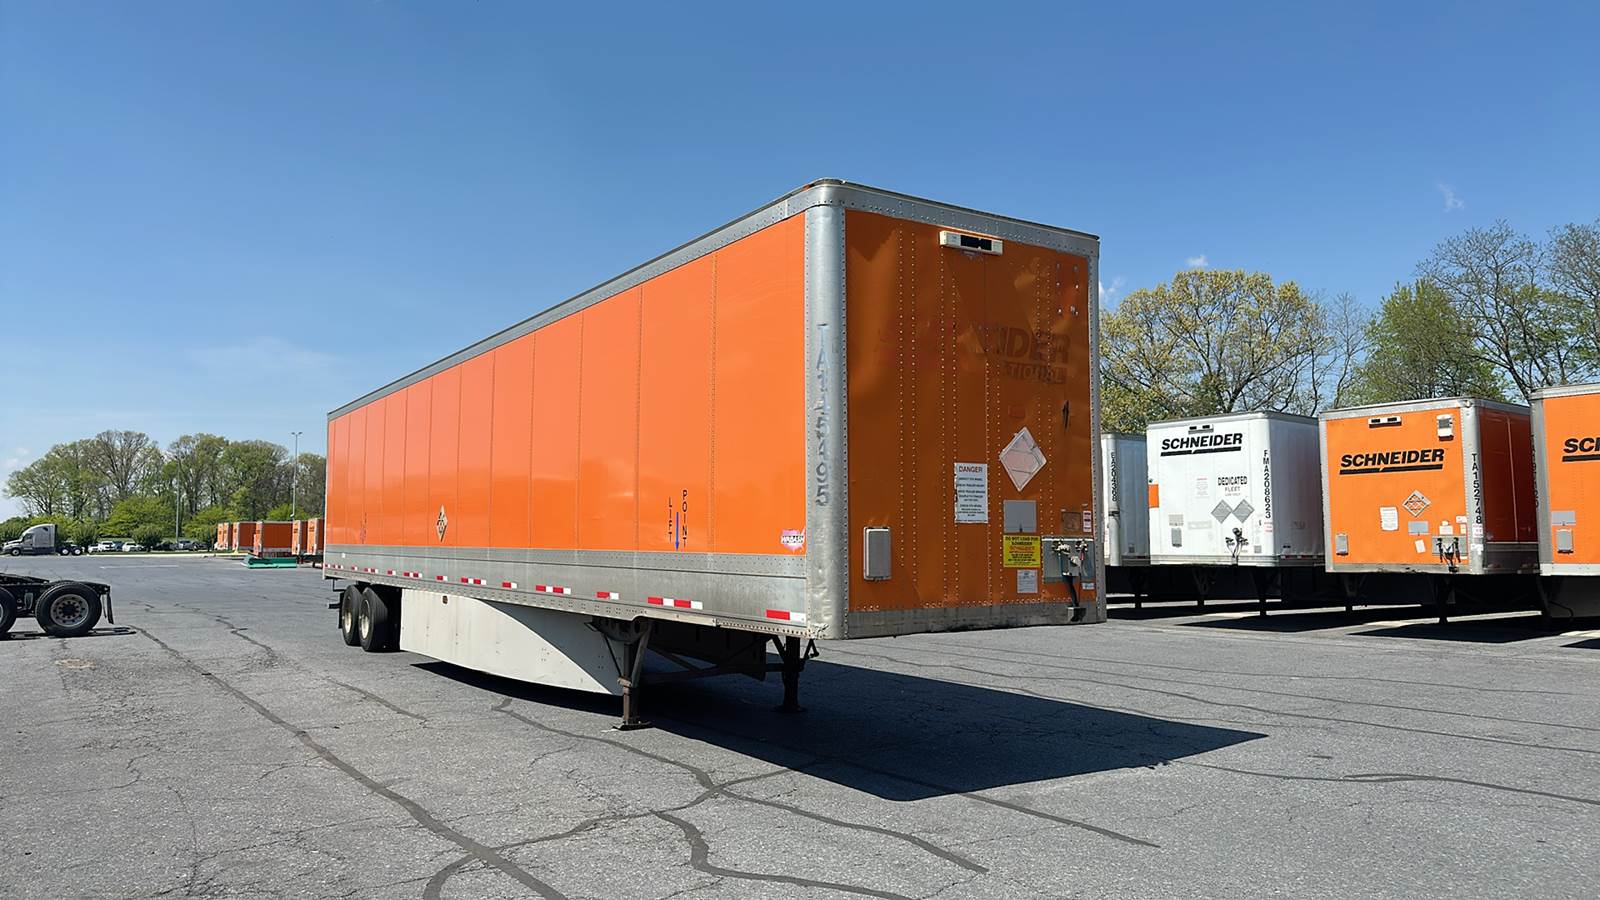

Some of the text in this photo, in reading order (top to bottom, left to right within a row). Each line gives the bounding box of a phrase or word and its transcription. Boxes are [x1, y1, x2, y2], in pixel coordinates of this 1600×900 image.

[1161, 433, 1243, 450] SCHNEIDER
[1340, 448, 1445, 467] SCHNEIDER
[958, 465, 983, 473] DANGER
[1217, 475, 1248, 486] DEDICATED
[1263, 449, 1271, 519] FMA208623
[1471, 453, 1483, 524] TA152748
